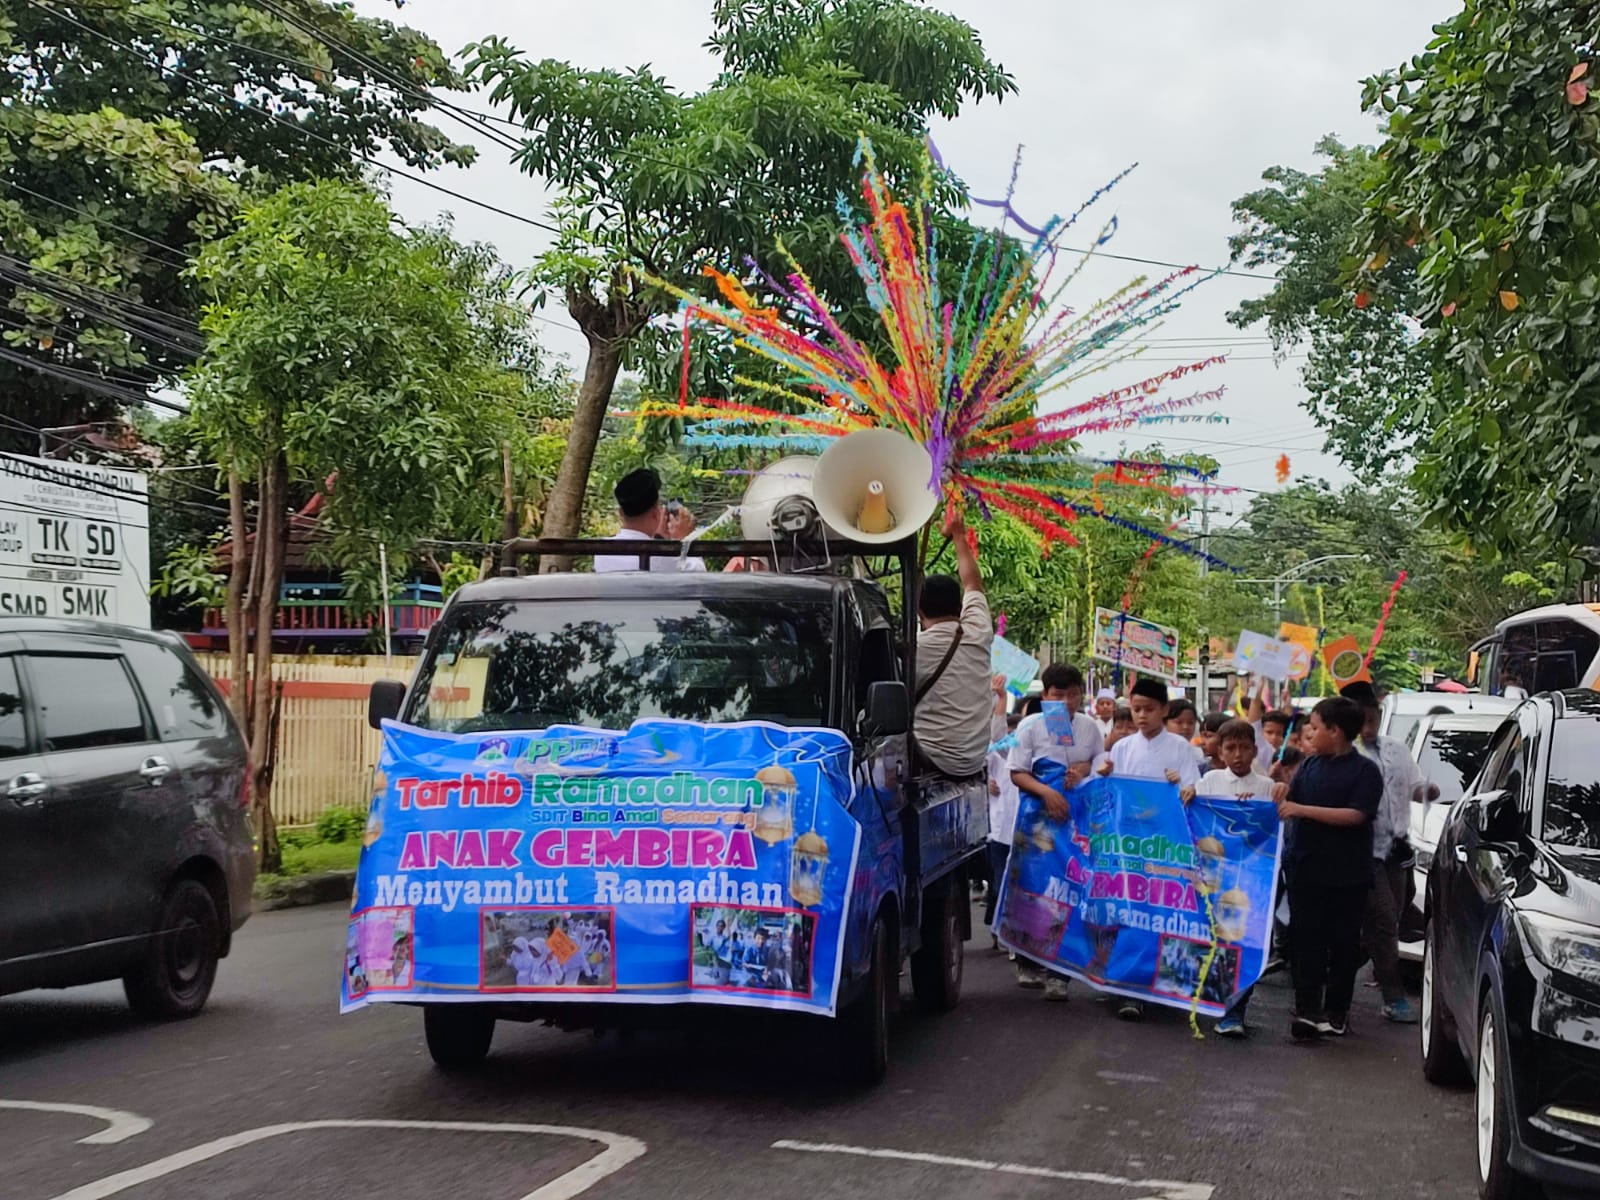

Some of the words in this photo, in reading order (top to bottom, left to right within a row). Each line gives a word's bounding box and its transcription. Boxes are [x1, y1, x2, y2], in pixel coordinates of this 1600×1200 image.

[38, 518, 70, 551] TK
[87, 524, 115, 555] SD
[63, 587, 108, 616] SMK
[396, 772, 522, 810] Tarhib
[532, 771, 765, 808] Ramadhan
[572, 810, 609, 824] Bina
[614, 809, 658, 824] Amal
[662, 810, 757, 830] Semarang
[399, 830, 525, 870] ANAK
[531, 828, 758, 869] GEMBIRA
[374, 872, 569, 912] Menyambut
[594, 871, 783, 907] Ramadhan
